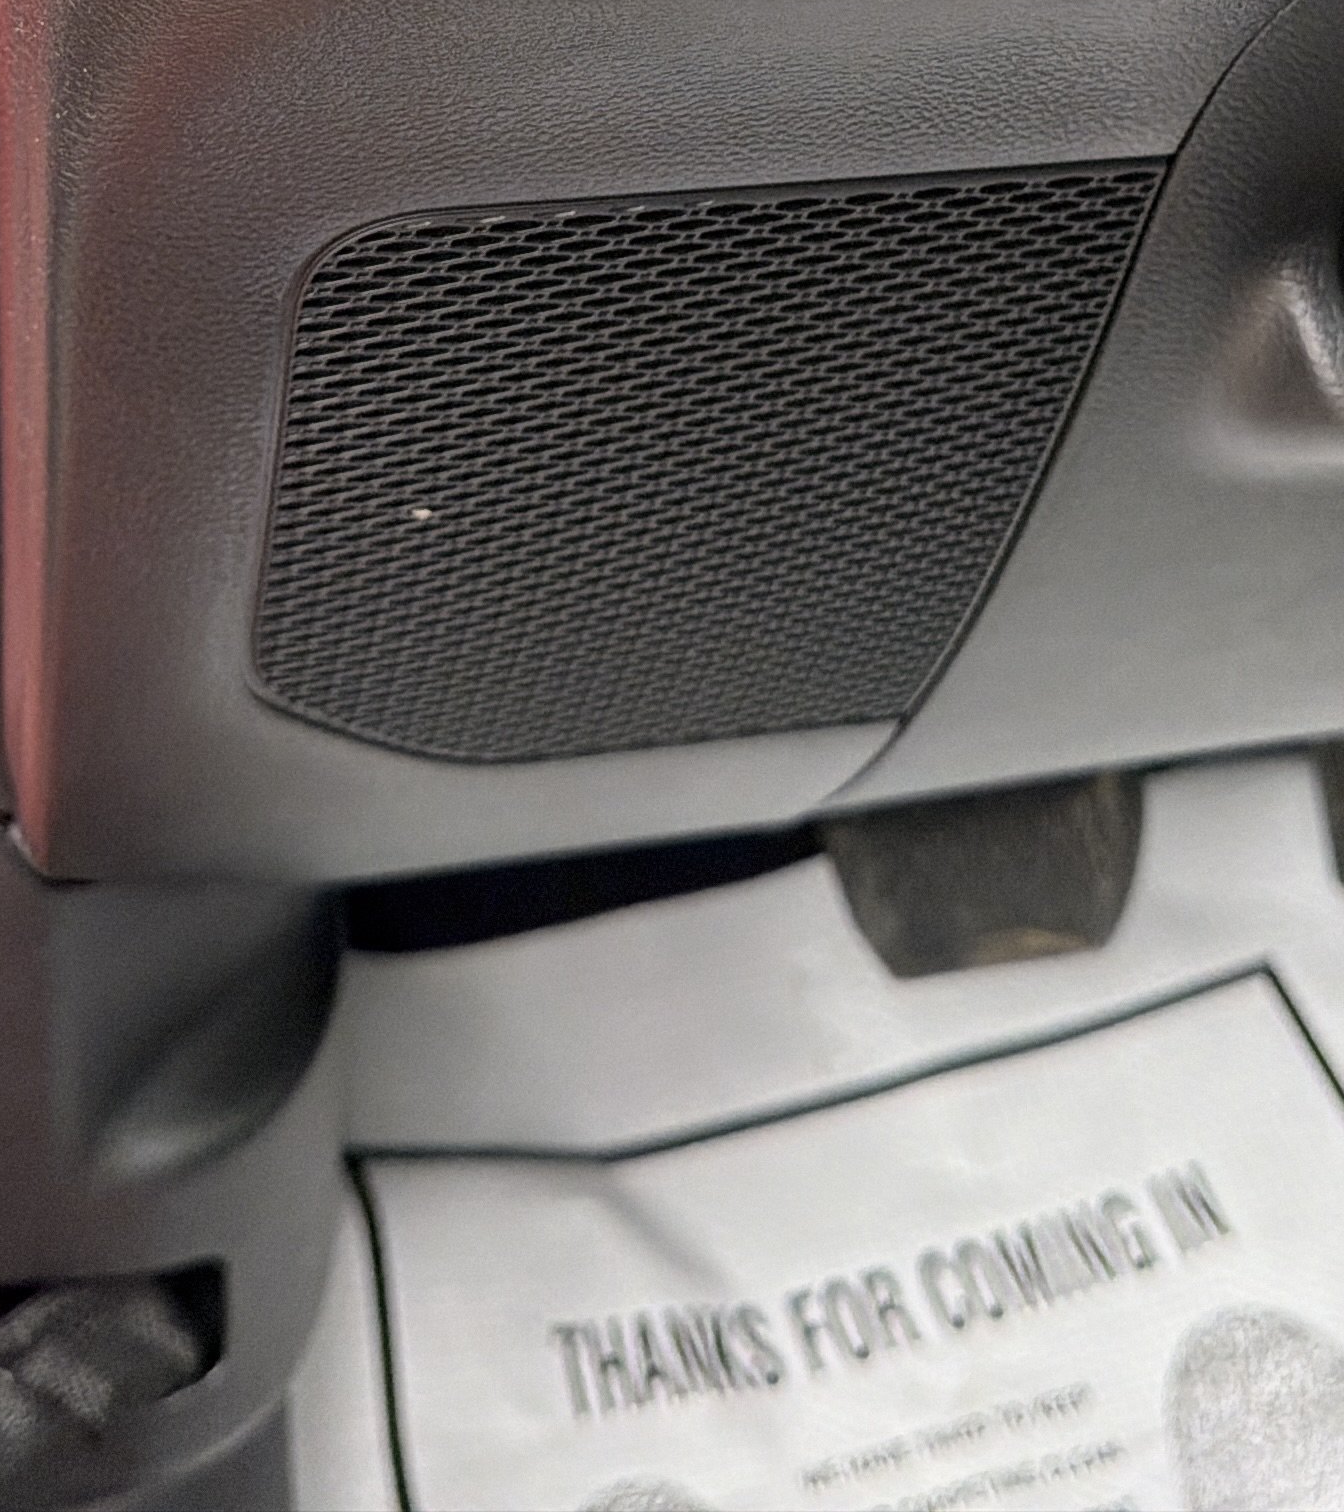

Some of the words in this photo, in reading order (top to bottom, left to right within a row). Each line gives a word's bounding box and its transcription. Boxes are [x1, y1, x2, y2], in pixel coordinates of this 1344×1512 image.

[552, 1302, 782, 1416] THANKS
[788, 1264, 922, 1372] FOR
[916, 1186, 1158, 1330] COMING
[1144, 1158, 1232, 1256] IN
